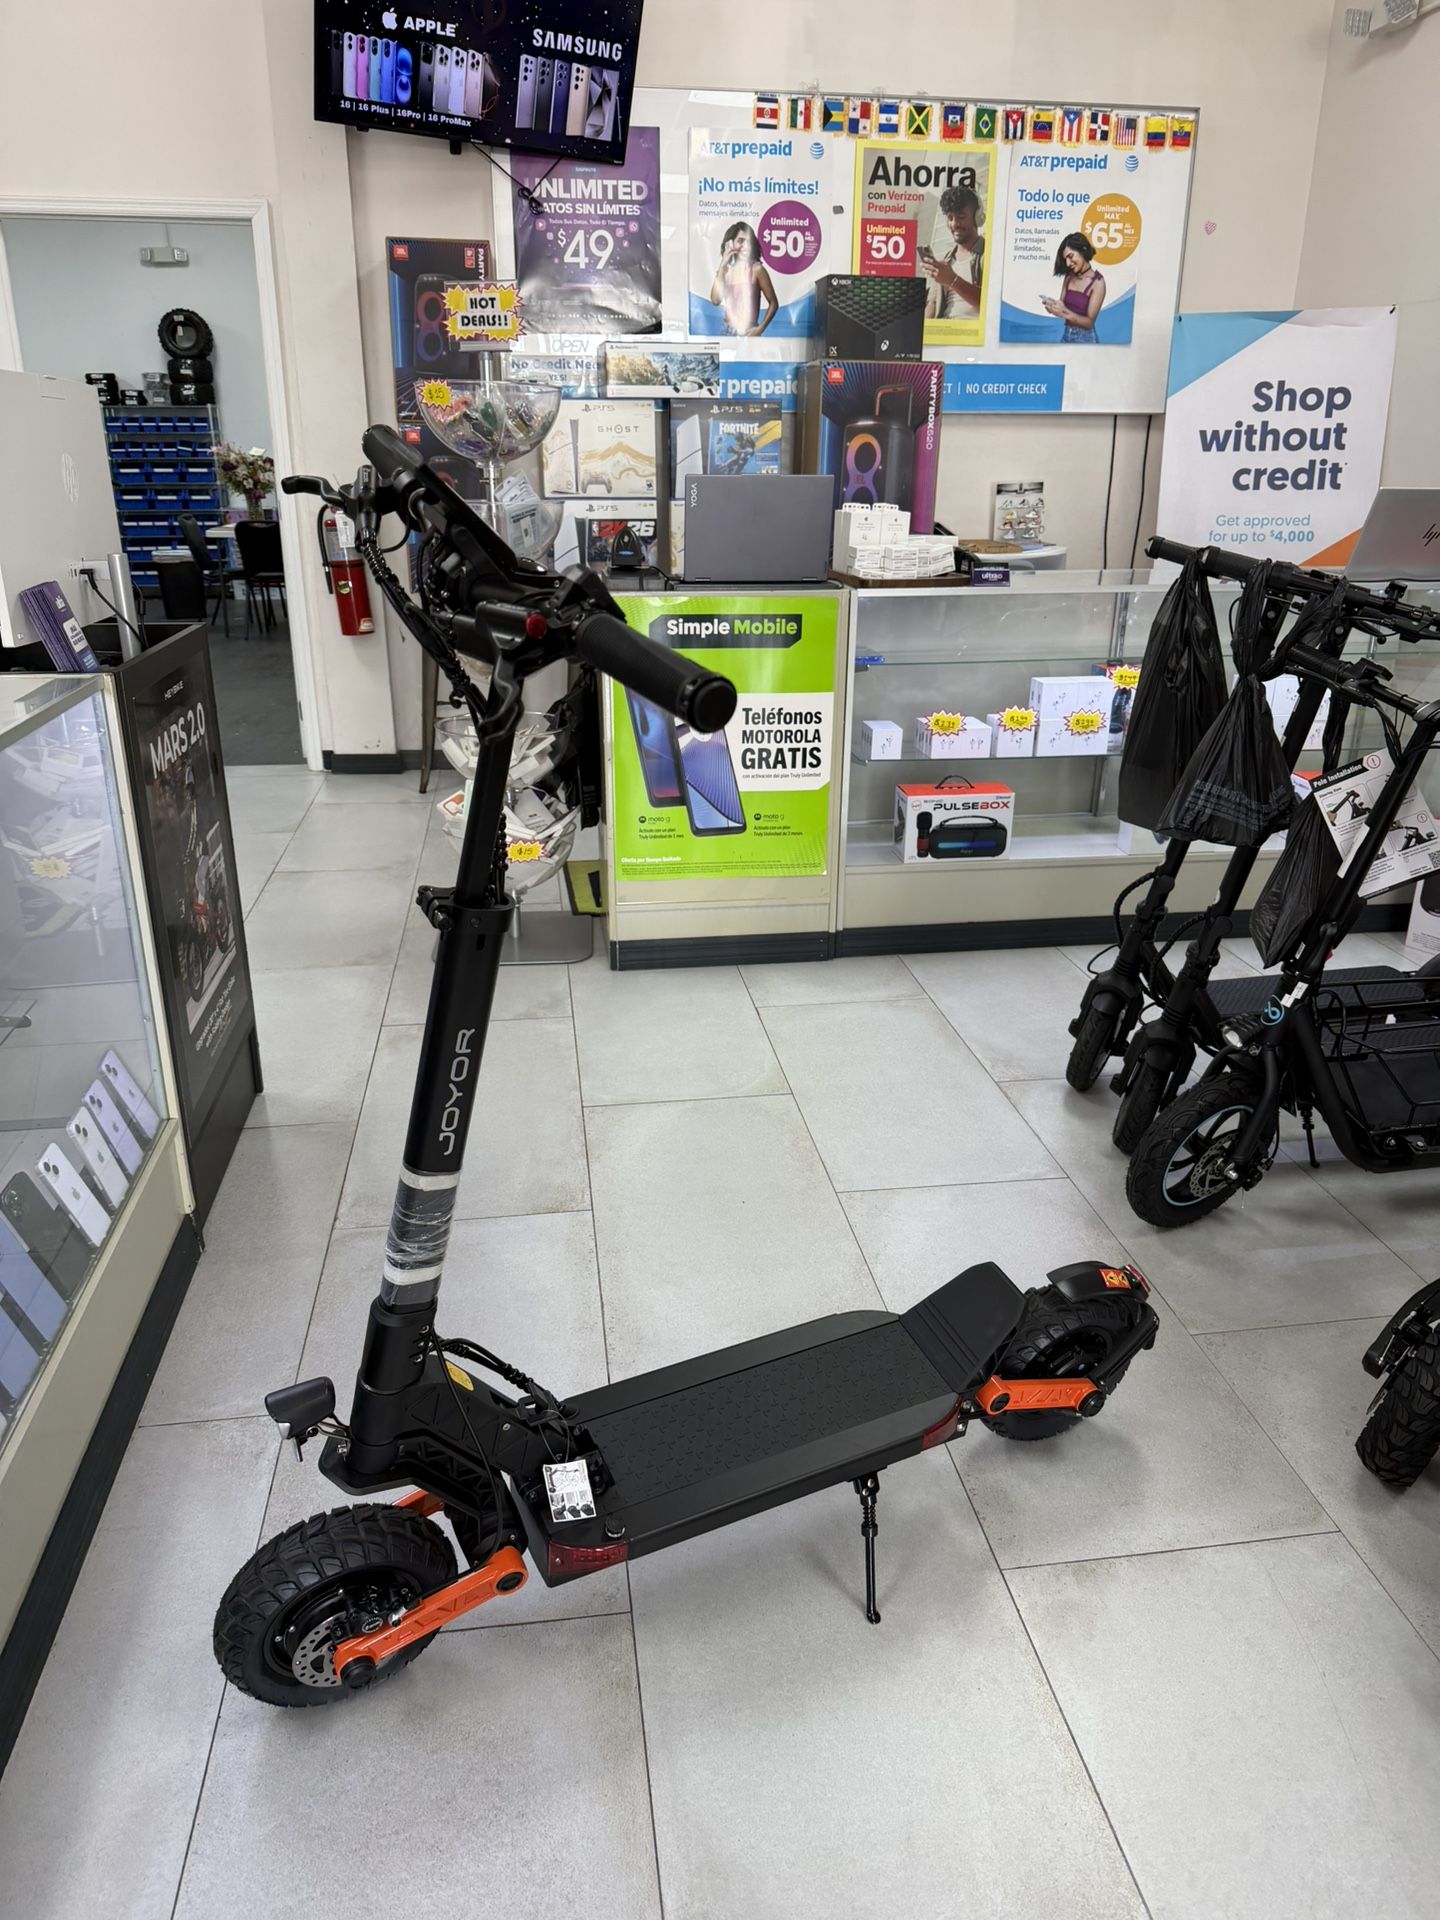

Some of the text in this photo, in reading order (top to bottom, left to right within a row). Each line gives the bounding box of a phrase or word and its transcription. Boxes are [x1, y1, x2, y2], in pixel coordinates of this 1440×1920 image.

[404, 16, 456, 37] APPLE
[533, 28, 622, 62] SAMSUNG
[340, 100, 351, 109] 16
[358, 103, 389, 115] 16 Plus
[396, 109, 421, 119] 16Pro
[428, 113, 472, 127] 16 ProMax
[732, 139, 792, 159] prepaid
[1020, 154, 1108, 172] AT&T prepaid
[868, 156, 976, 189] Ahorra
[699, 176, 819, 195] ¡No más límites!
[867, 190, 925, 202] con Verizon
[1018, 189, 1090, 207] Todo lo que
[541, 201, 641, 216] ATOS SIN LÍMITES
[867, 202, 906, 215] Prepaid
[1016, 207, 1063, 222] quieres
[1097, 205, 1130, 213] Unlimited
[770, 217, 809, 227] Unlimited
[866, 224, 905, 235] Unlimited
[1034, 227, 1060, 236] llamadas
[1085, 221, 1124, 249] $65
[763, 229, 804, 259] $50
[866, 234, 906, 261] $50
[1019, 237, 1046, 245] mensajes
[557, 228, 614, 270] $49
[1038, 253, 1051, 261] más
[470, 298, 496, 309] HOT
[461, 314, 508, 327] DEALS!!
[512, 359, 528, 369] No
[966, 383, 980, 395] NO
[982, 383, 1016, 395] CREDIT
[1018, 383, 1047, 395] CHECK
[1252, 380, 1352, 418] Shop
[721, 405, 743, 413] PS5
[598, 424, 640, 434] GHOST
[720, 422, 759, 434] FORTNITE
[1199, 420, 1347, 452] without
[690, 482, 698, 508] YOGA
[597, 504, 618, 512] PS5
[627, 521, 655, 537] 26
[1216, 514, 1310, 529] Get approved
[1209, 530, 1314, 545] for up to $4,000
[666, 618, 798, 638] Simple Mobile
[742, 707, 822, 725] Teléfonos
[149, 702, 206, 780] MARS 2.0
[742, 729, 821, 744] MOTOROLA
[741, 747, 822, 770] GRATIS
[1328, 764, 1362, 782] Installation
[933, 801, 1010, 811] PULSEBOX
[438, 1028, 476, 1156] JOYOR
